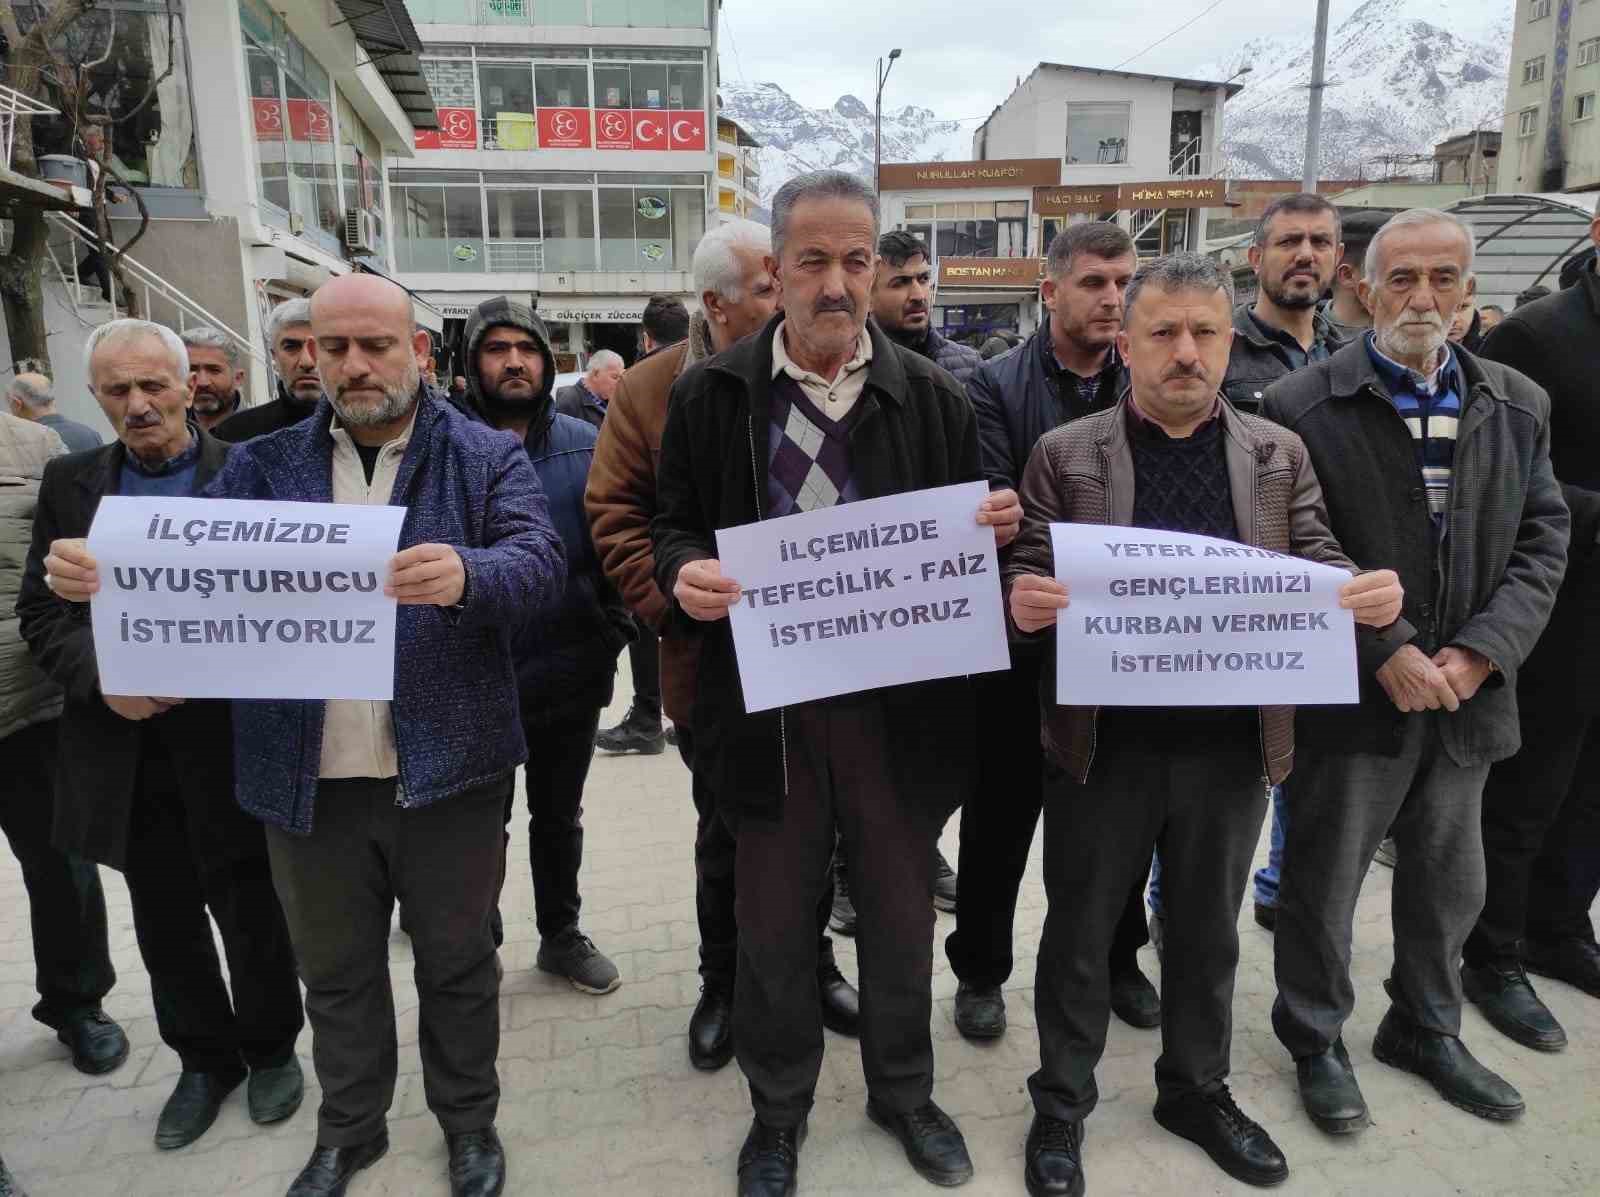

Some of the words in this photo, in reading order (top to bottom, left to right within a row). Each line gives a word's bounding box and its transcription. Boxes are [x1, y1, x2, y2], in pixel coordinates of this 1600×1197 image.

[946, 267, 991, 277] BOSTAN
[147, 513, 351, 547] İLÇEMİZDE
[780, 519, 939, 562] İLÇEMİZDE
[1104, 543, 1195, 558] YETER
[113, 566, 378, 599] UYUŞTURUCU
[741, 566, 895, 609] TEFECİLİK
[920, 552, 988, 582] FAİZ
[1109, 571, 1311, 600] GENÇLERİMİZİ
[120, 611, 377, 644] İSTEMİYORUZ
[769, 597, 972, 648] İSTEMİYORUZ
[1084, 615, 1201, 635] KURBAN
[1212, 612, 1329, 633] VERMEK
[1111, 649, 1305, 673] İSTEMİYORUZ
